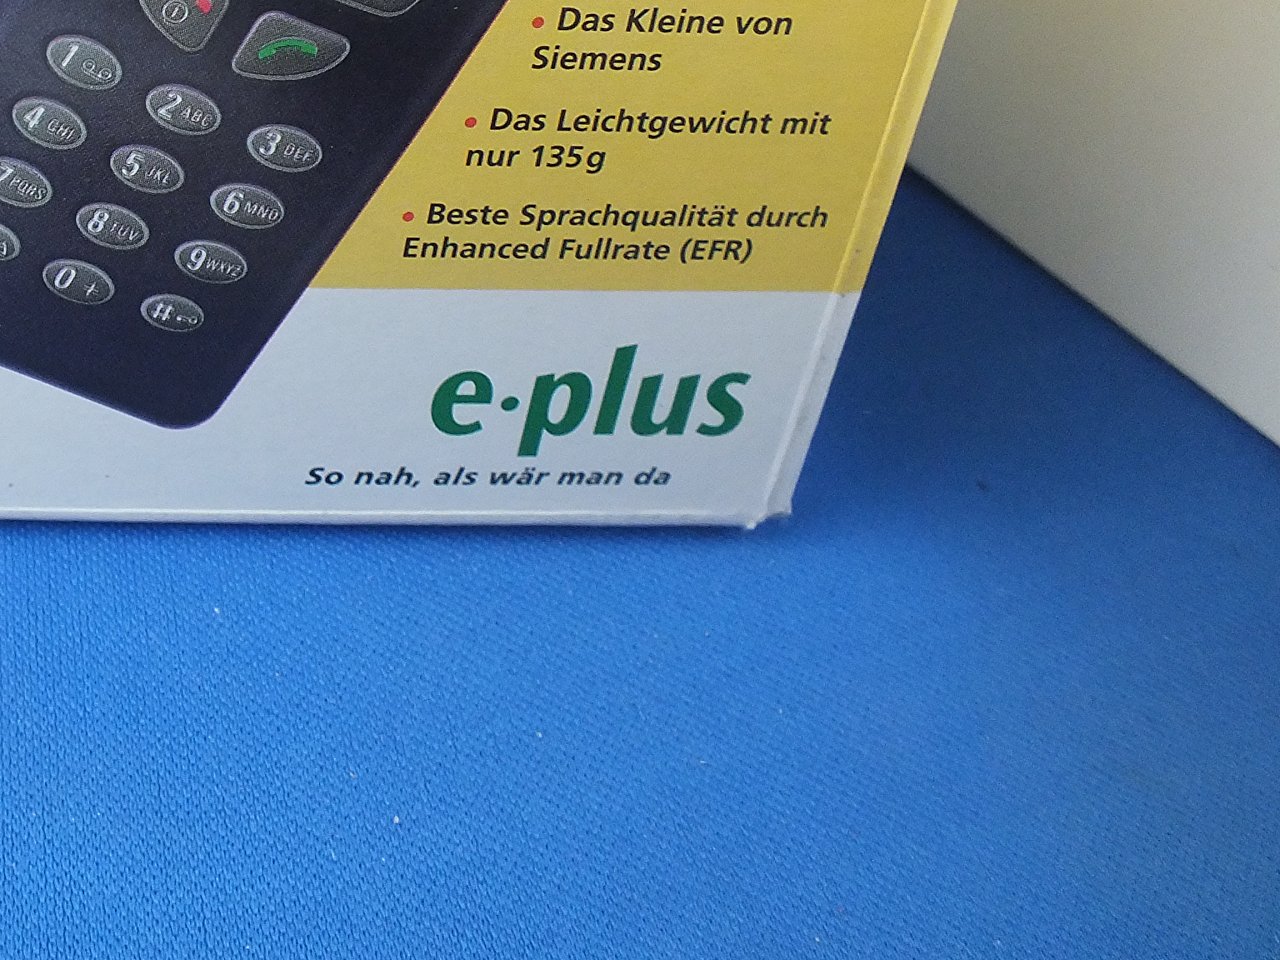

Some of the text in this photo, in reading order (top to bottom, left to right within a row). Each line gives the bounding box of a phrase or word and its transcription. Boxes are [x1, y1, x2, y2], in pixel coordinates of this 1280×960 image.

[556, 6, 793, 36] Das Kleine von
[60, 43, 79, 67] 1
[531, 44, 662, 71] Siemens
[22, 105, 46, 130] 4
[158, 92, 182, 120] 2
[489, 107, 832, 138] Das Leichtgewicht mit
[258, 129, 281, 156] 3
[121, 151, 145, 178] 5
[465, 146, 606, 174] nur 135g
[223, 190, 244, 215] 6
[87, 208, 110, 233] 8
[426, 203, 829, 233] Beste Sprachqualität durch
[187, 247, 207, 271] 9
[402, 237, 752, 264] Enhanced Fullrate (EFR)
[305, 467, 671, 489] So nah, als wär man da
